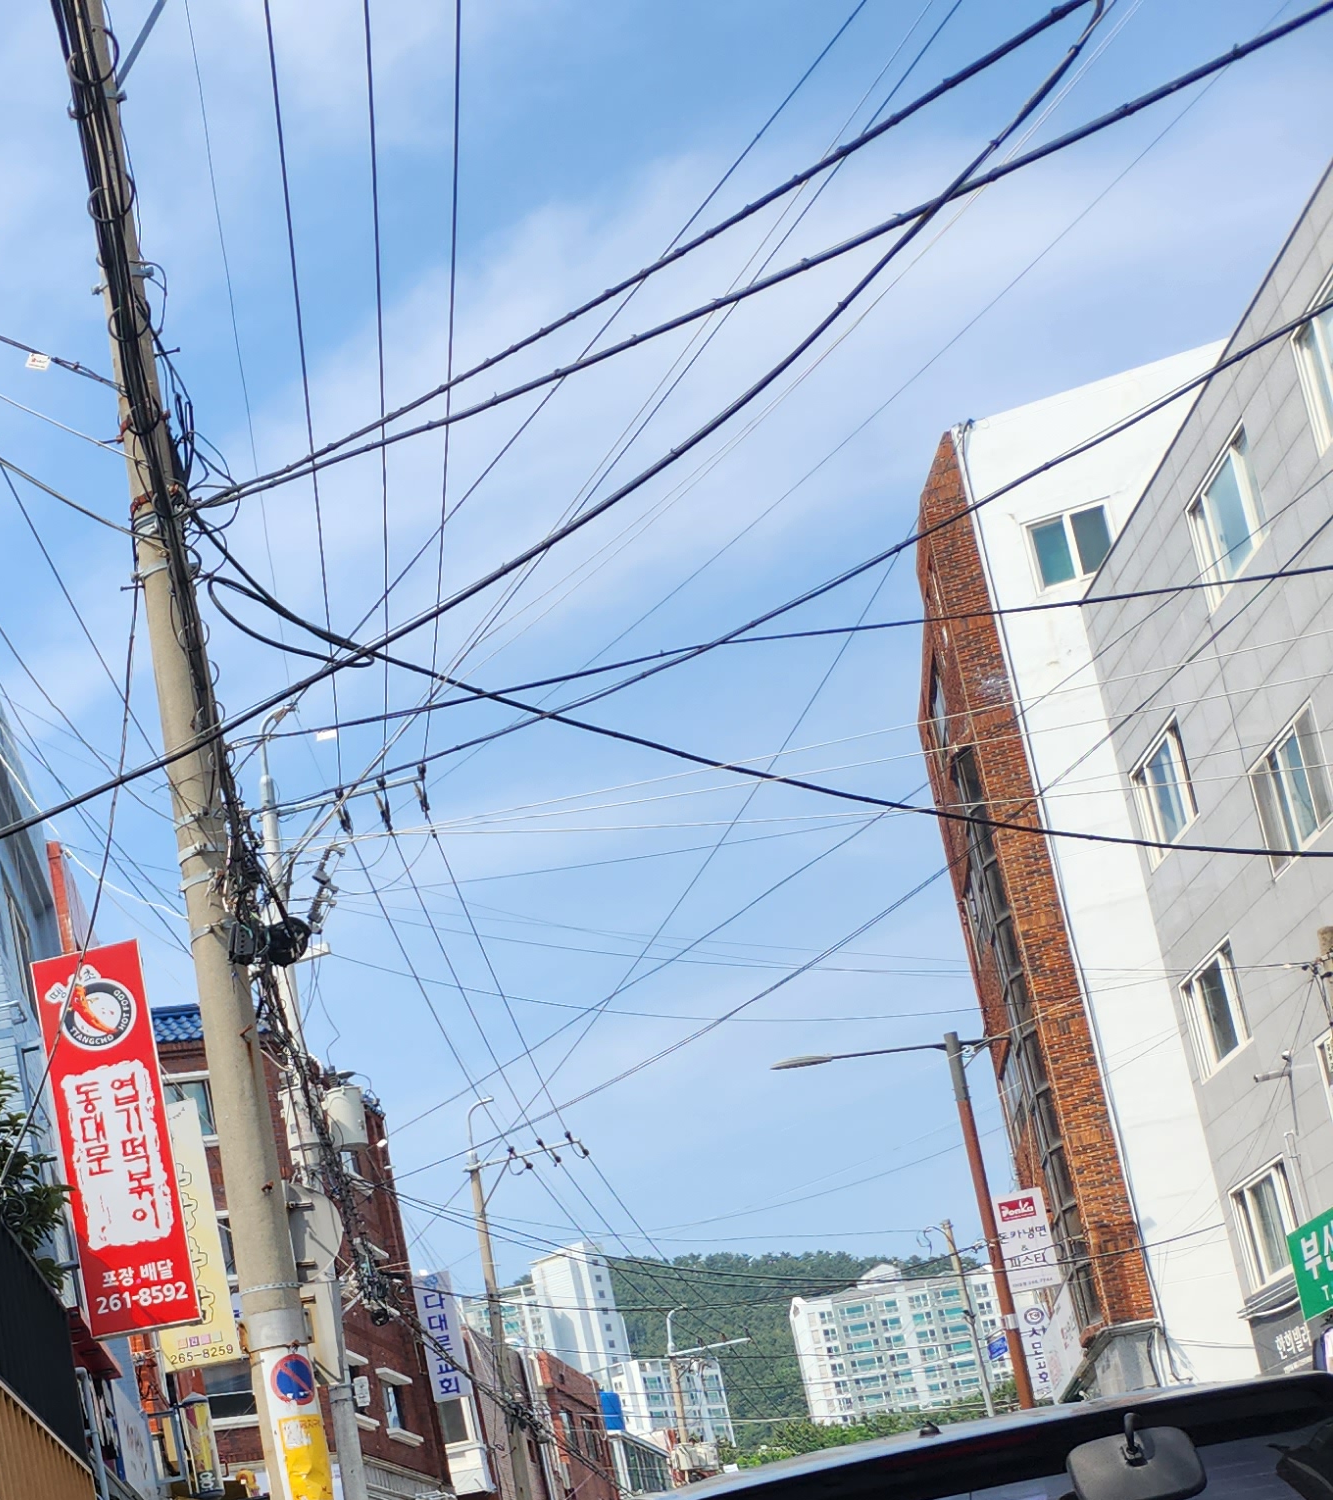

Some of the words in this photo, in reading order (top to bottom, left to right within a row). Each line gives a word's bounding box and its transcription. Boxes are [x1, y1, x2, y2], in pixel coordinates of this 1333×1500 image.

[75, 1080, 114, 1177] 동대문
[110, 1071, 162, 1229] 엽기떡볶이
[96, 1281, 190, 1315] 261-8592
[170, 1345, 234, 1365] 265-8259
